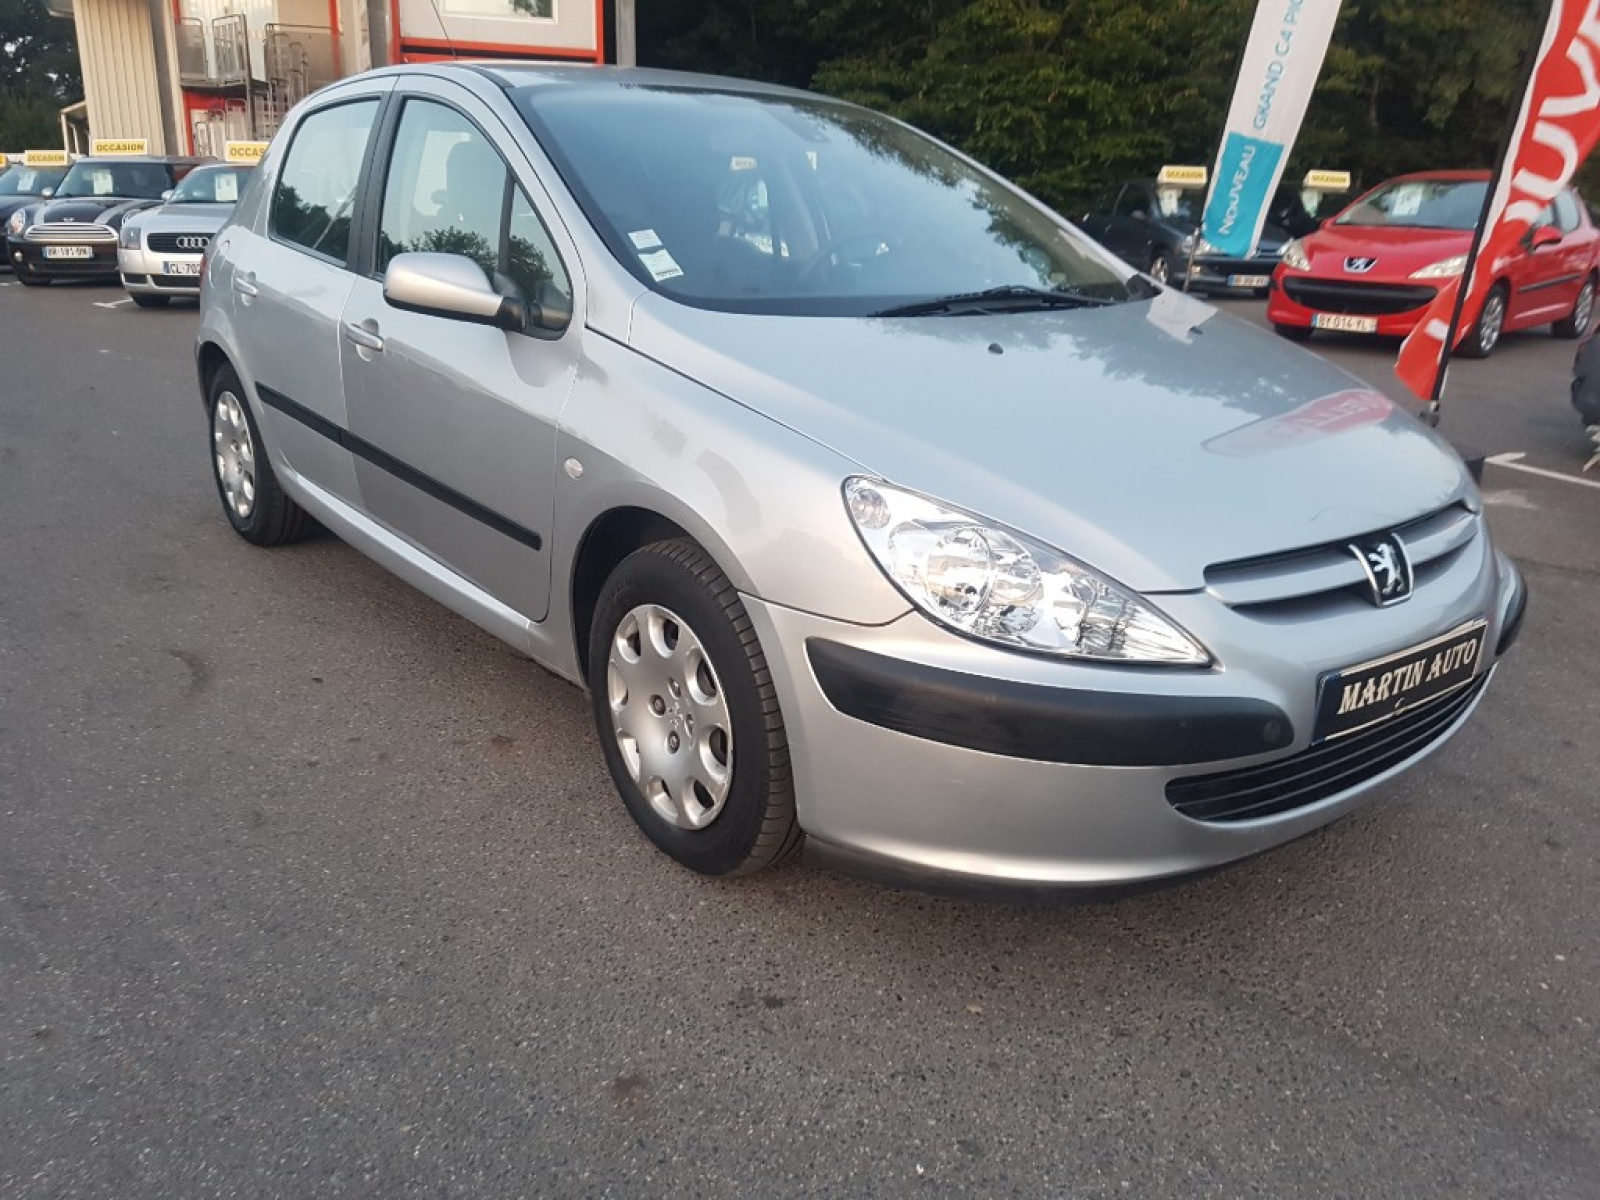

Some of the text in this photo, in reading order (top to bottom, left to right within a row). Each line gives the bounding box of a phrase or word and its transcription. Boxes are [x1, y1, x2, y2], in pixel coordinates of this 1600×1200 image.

[1253, 60, 1284, 129] GRAND
[1275, 30, 1292, 56] C4
[27, 154, 65, 162] OCCASION
[96, 142, 145, 151] OCCASION
[1217, 144, 1257, 235] NOUVEAU
[1336, 637, 1478, 715] MARTIN AUTO
